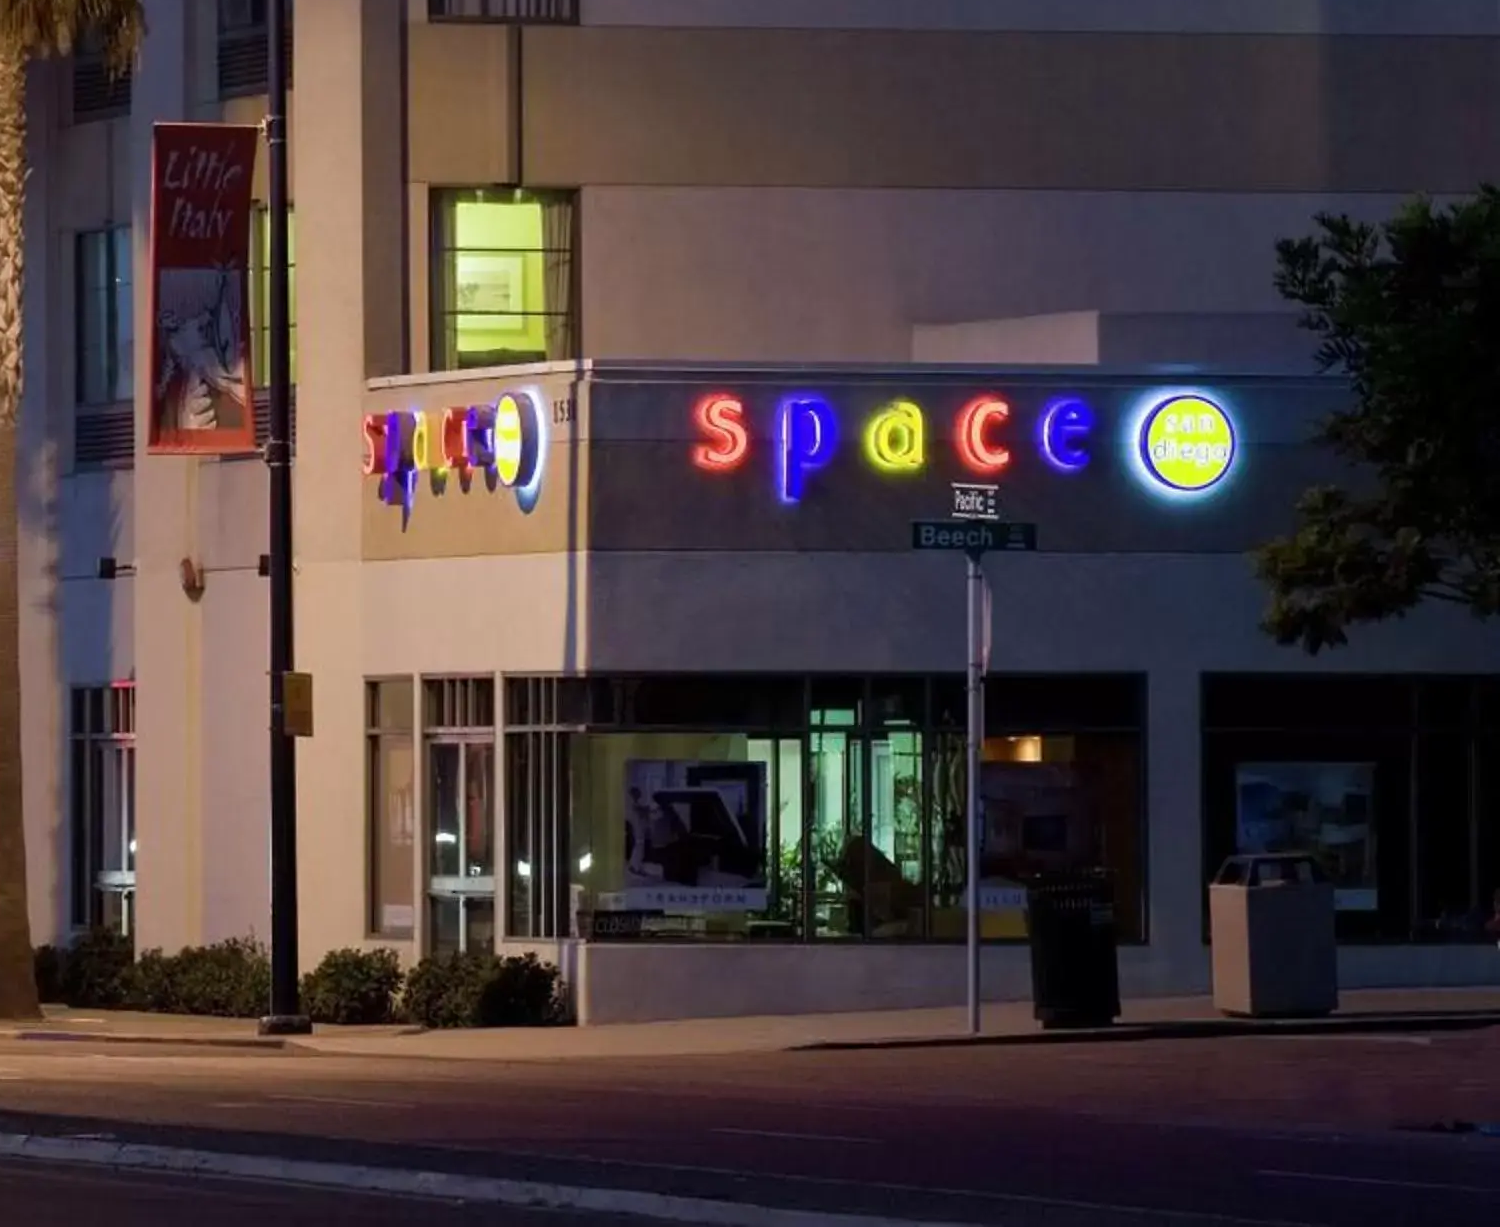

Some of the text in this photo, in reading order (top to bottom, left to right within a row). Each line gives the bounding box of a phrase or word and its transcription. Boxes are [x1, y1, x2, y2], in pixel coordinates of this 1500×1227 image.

[164, 139, 242, 190] Little
[169, 191, 234, 238] Italy
[1165, 414, 1213, 433] san
[694, 400, 1093, 502] space
[1153, 440, 1227, 466] diego
[955, 490, 984, 511] Pacific
[920, 525, 993, 546] Beech
